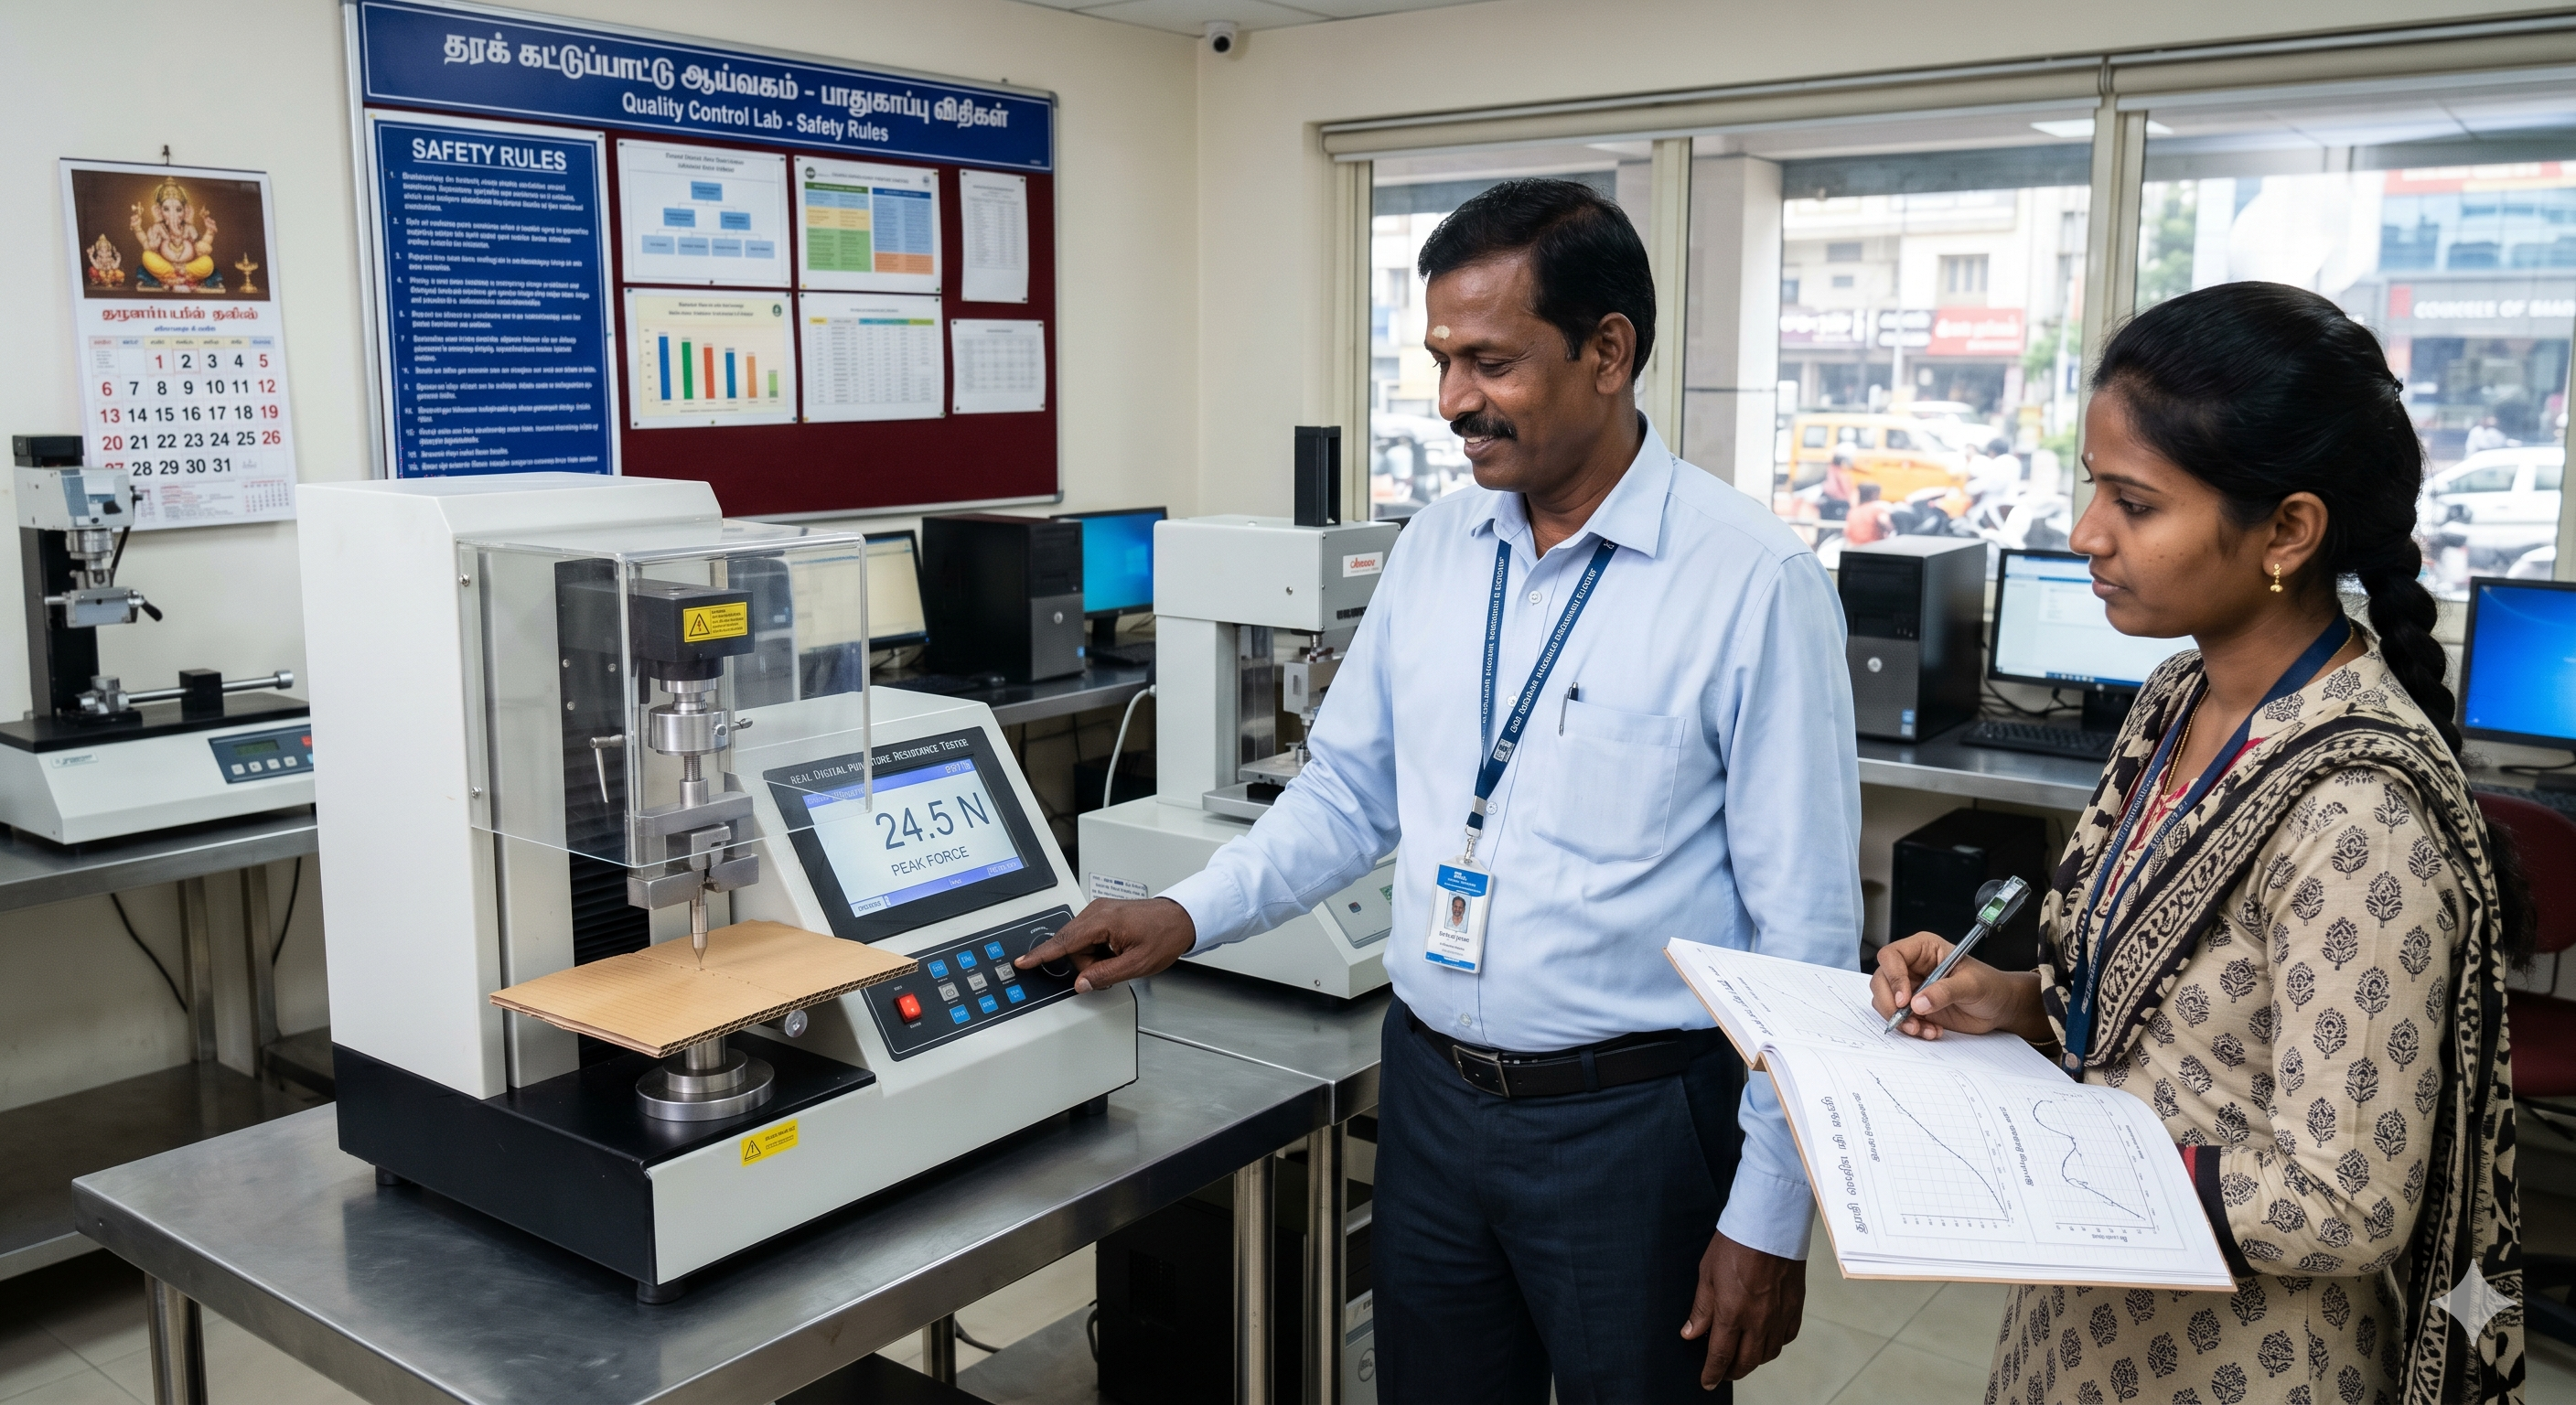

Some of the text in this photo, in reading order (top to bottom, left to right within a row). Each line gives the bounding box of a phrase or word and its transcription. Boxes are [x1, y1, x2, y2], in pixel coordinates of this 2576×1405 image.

[444, 31, 511, 66] தரக்
[518, 44, 675, 91] கட்டுப்பாட்டு
[681, 62, 799, 101] ஆய்வகம்
[821, 84, 930, 125] பாதுகாப்பு
[933, 96, 1009, 129] விதிகள்
[622, 91, 684, 123] Quality
[688, 100, 750, 126] Control
[753, 107, 783, 131] Lab
[796, 113, 844, 142] Safety
[847, 119, 889, 143] Rules
[412, 137, 567, 171] SAFETY RULES
[155, 353, 269, 370] 1 2 3 4 5
[102, 379, 276, 397] 6 7 8 9 10 11 12
[100, 404, 279, 424] 13 14 15 16 17 18 19
[102, 430, 281, 451] 20 21 22 23 24 25 26
[132, 461, 153, 477] 28
[159, 459, 179, 475] 29
[186, 458, 207, 474] 30
[212, 457, 231, 473] 31
[789, 771, 813, 786] REAL
[875, 791, 991, 851] 24.5 N
[890, 857, 927, 876] PEAK
[926, 845, 970, 868] FORCE
